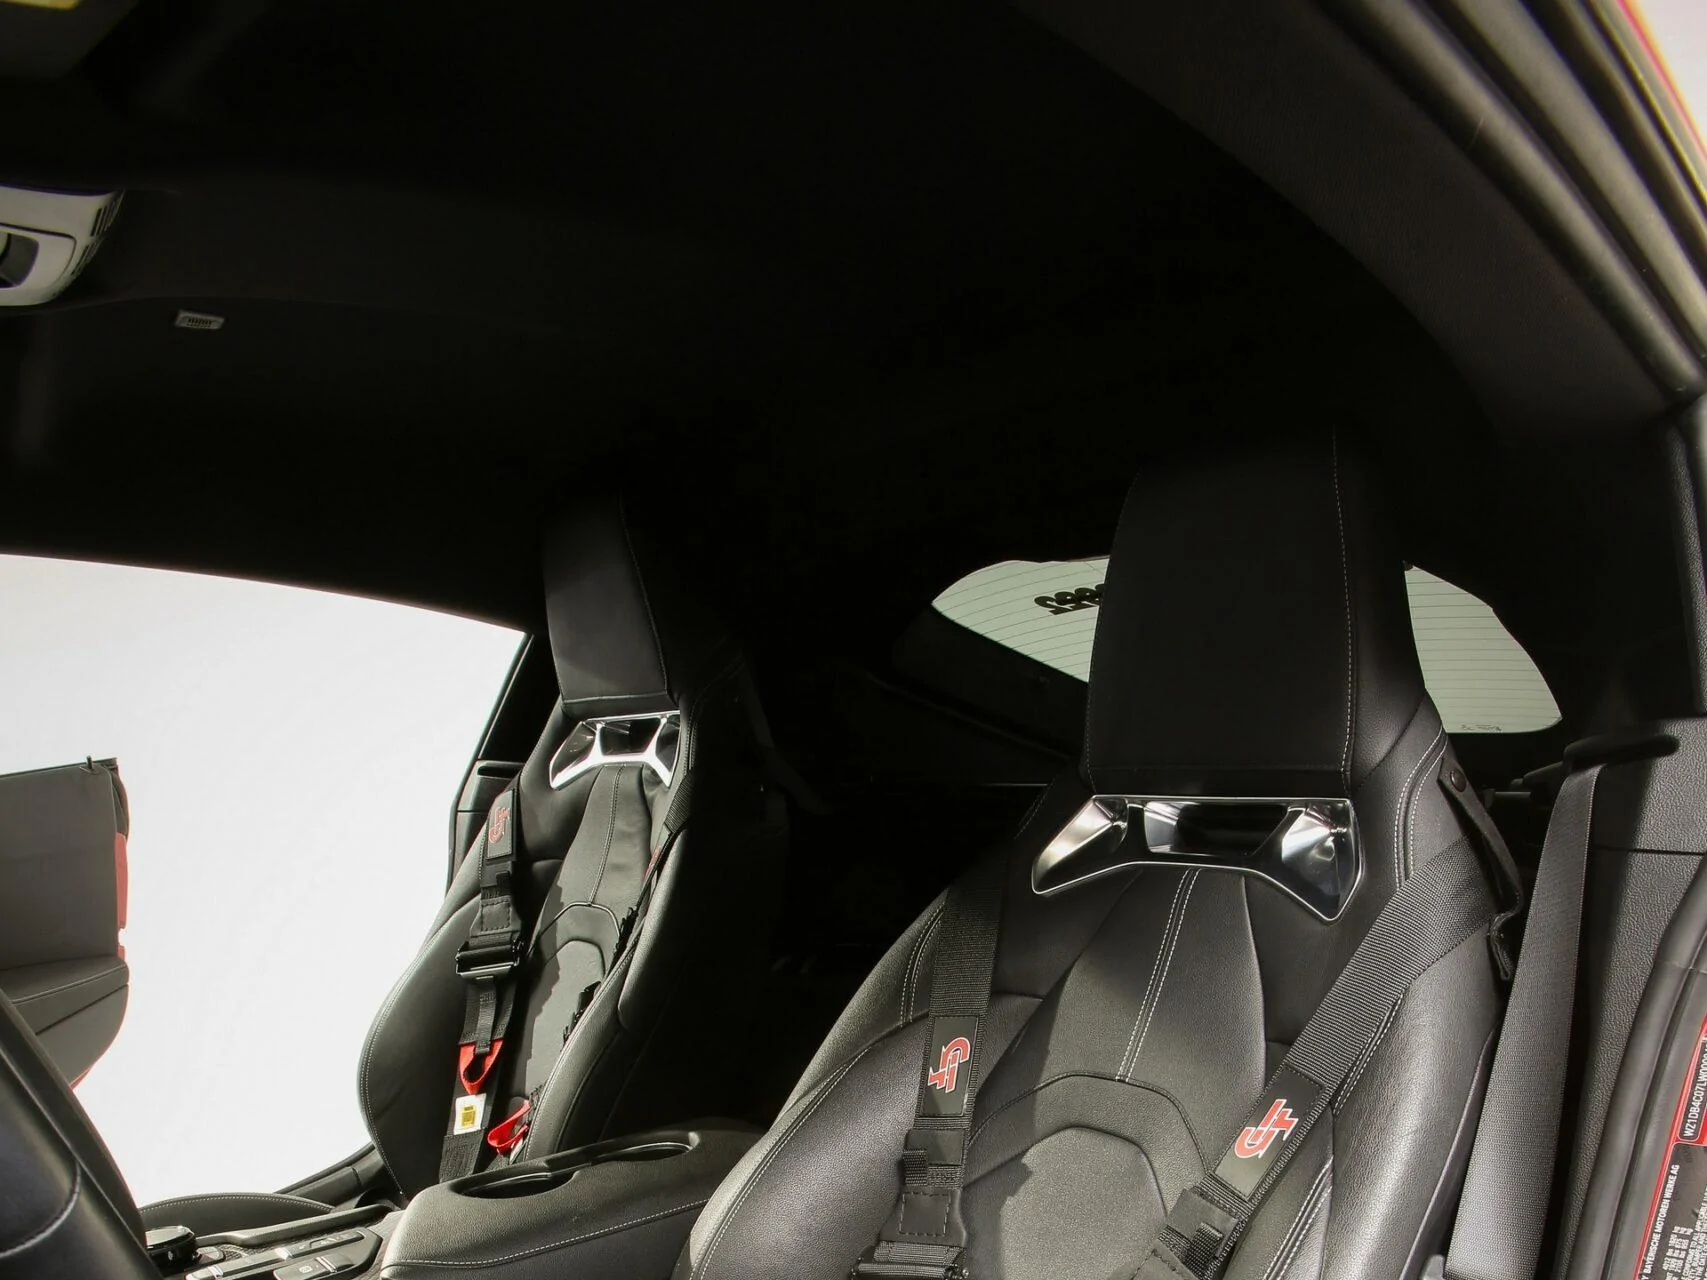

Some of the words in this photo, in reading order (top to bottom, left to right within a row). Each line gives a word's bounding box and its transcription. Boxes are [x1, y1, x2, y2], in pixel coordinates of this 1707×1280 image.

[1644, 1233, 1660, 1274] BAYERISCHE
[1654, 1199, 1670, 1232] MOTOREN
[1663, 1175, 1676, 1199] WERKE
[1670, 1165, 1679, 1174] AG
